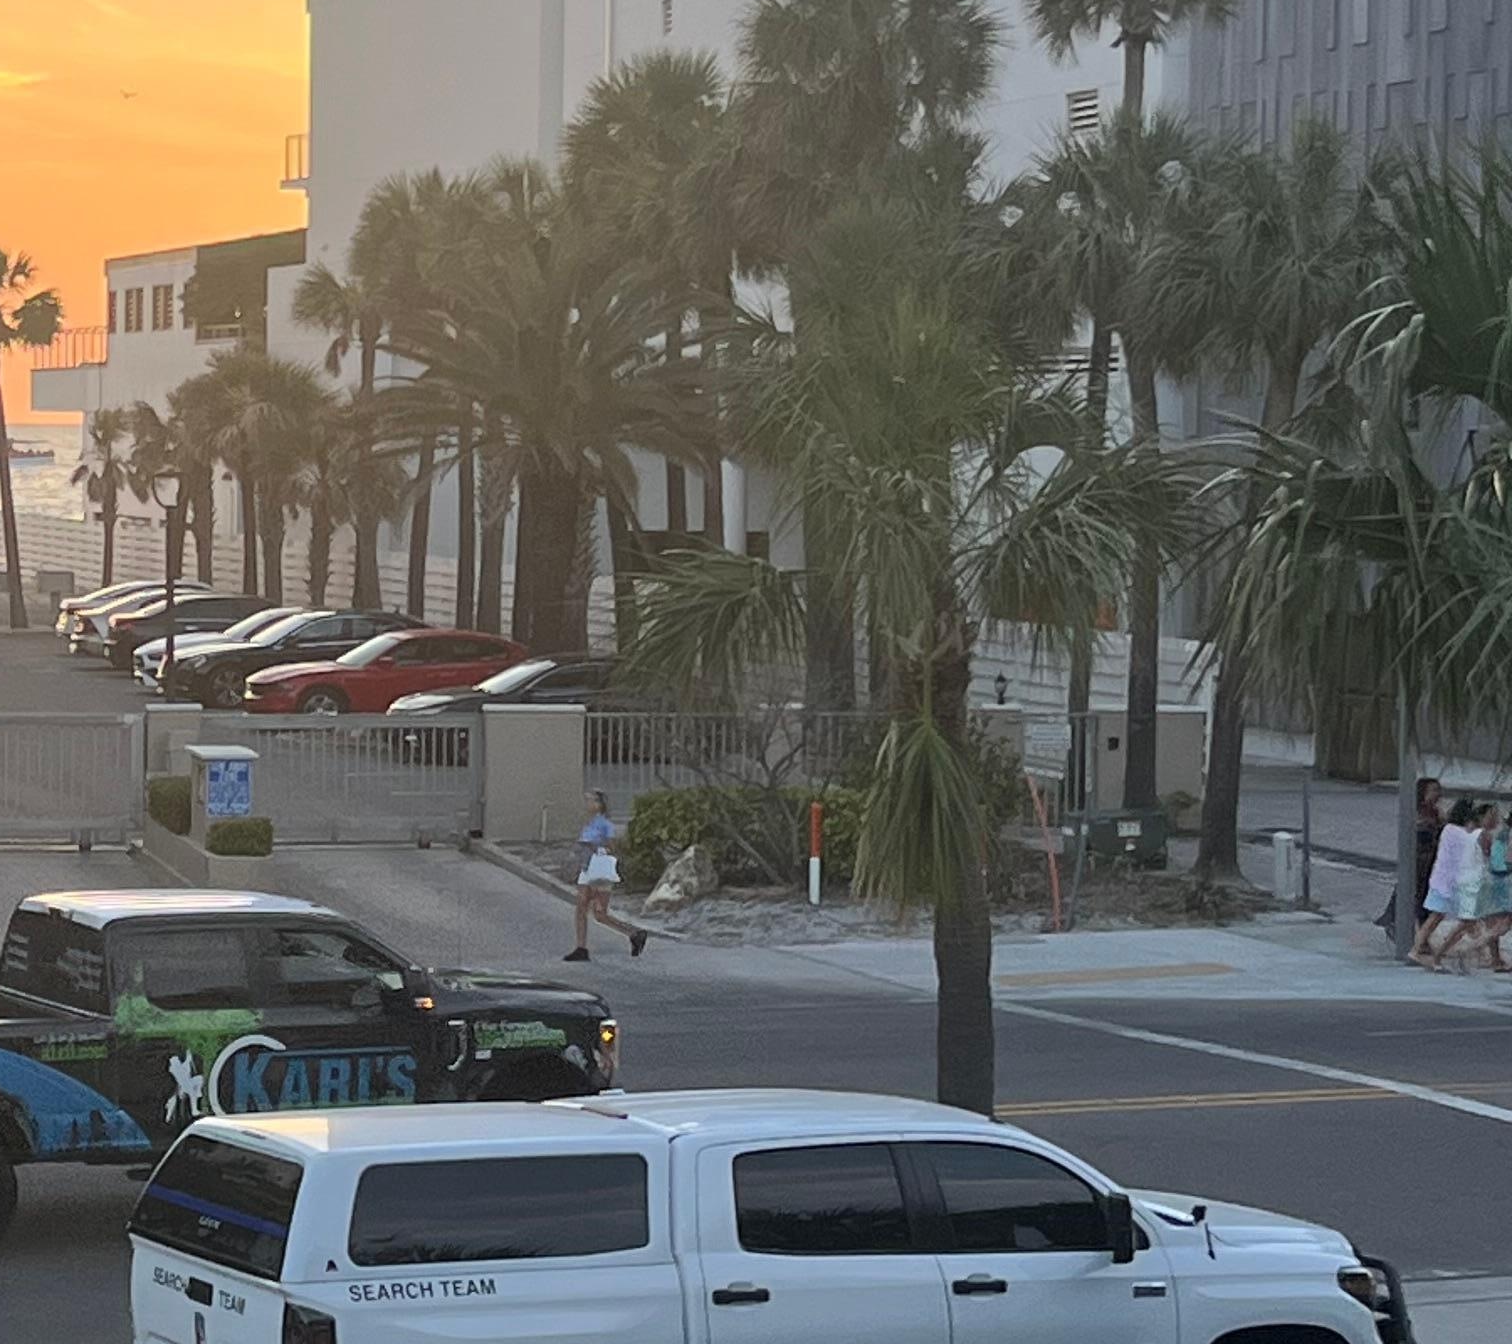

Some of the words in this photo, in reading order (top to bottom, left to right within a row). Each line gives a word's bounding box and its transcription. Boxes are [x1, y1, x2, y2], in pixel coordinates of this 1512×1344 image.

[348, 1281, 434, 1302] SEARCH
[439, 1278, 497, 1298] TEAM
[219, 1290, 245, 1315] TEAM
